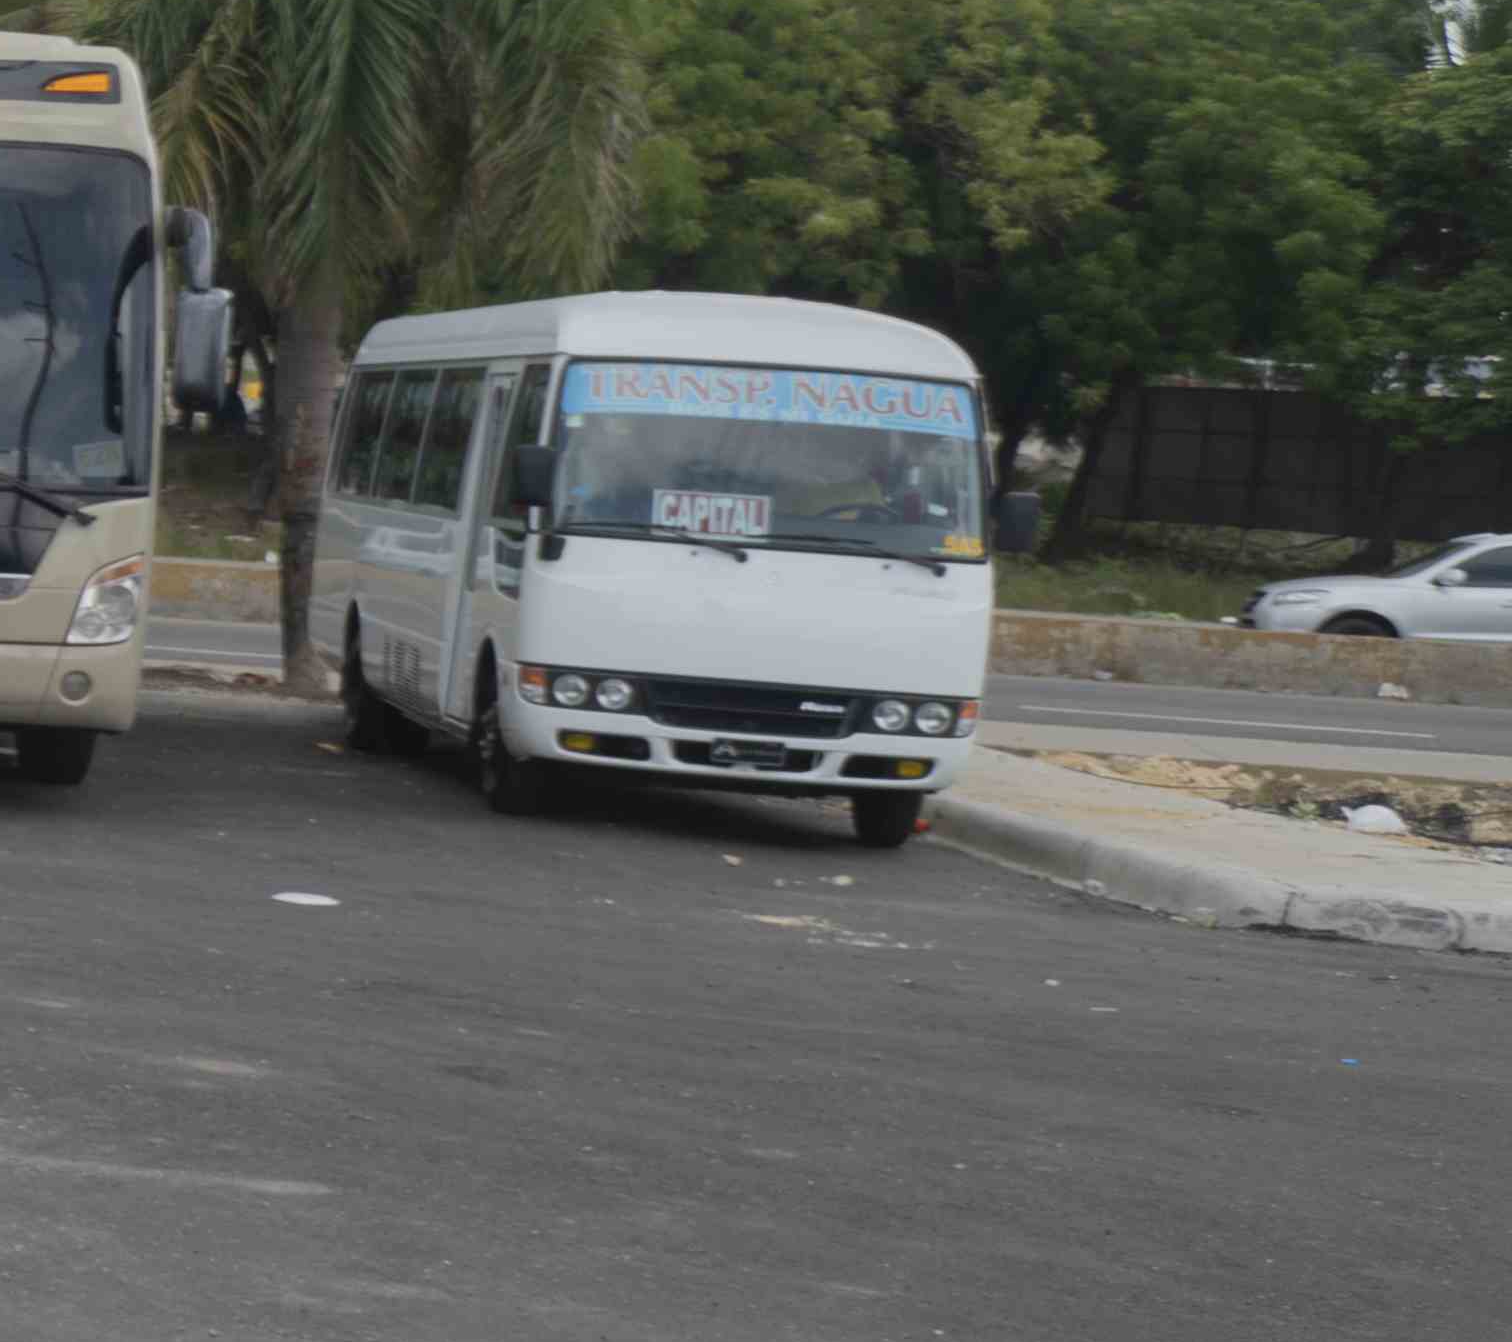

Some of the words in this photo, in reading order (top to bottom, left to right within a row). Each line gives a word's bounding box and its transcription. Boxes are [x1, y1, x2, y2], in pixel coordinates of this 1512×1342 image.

[586, 365, 775, 405] TRANSP.
[793, 374, 965, 424] NAGUA
[661, 493, 769, 535] CAPITAL
